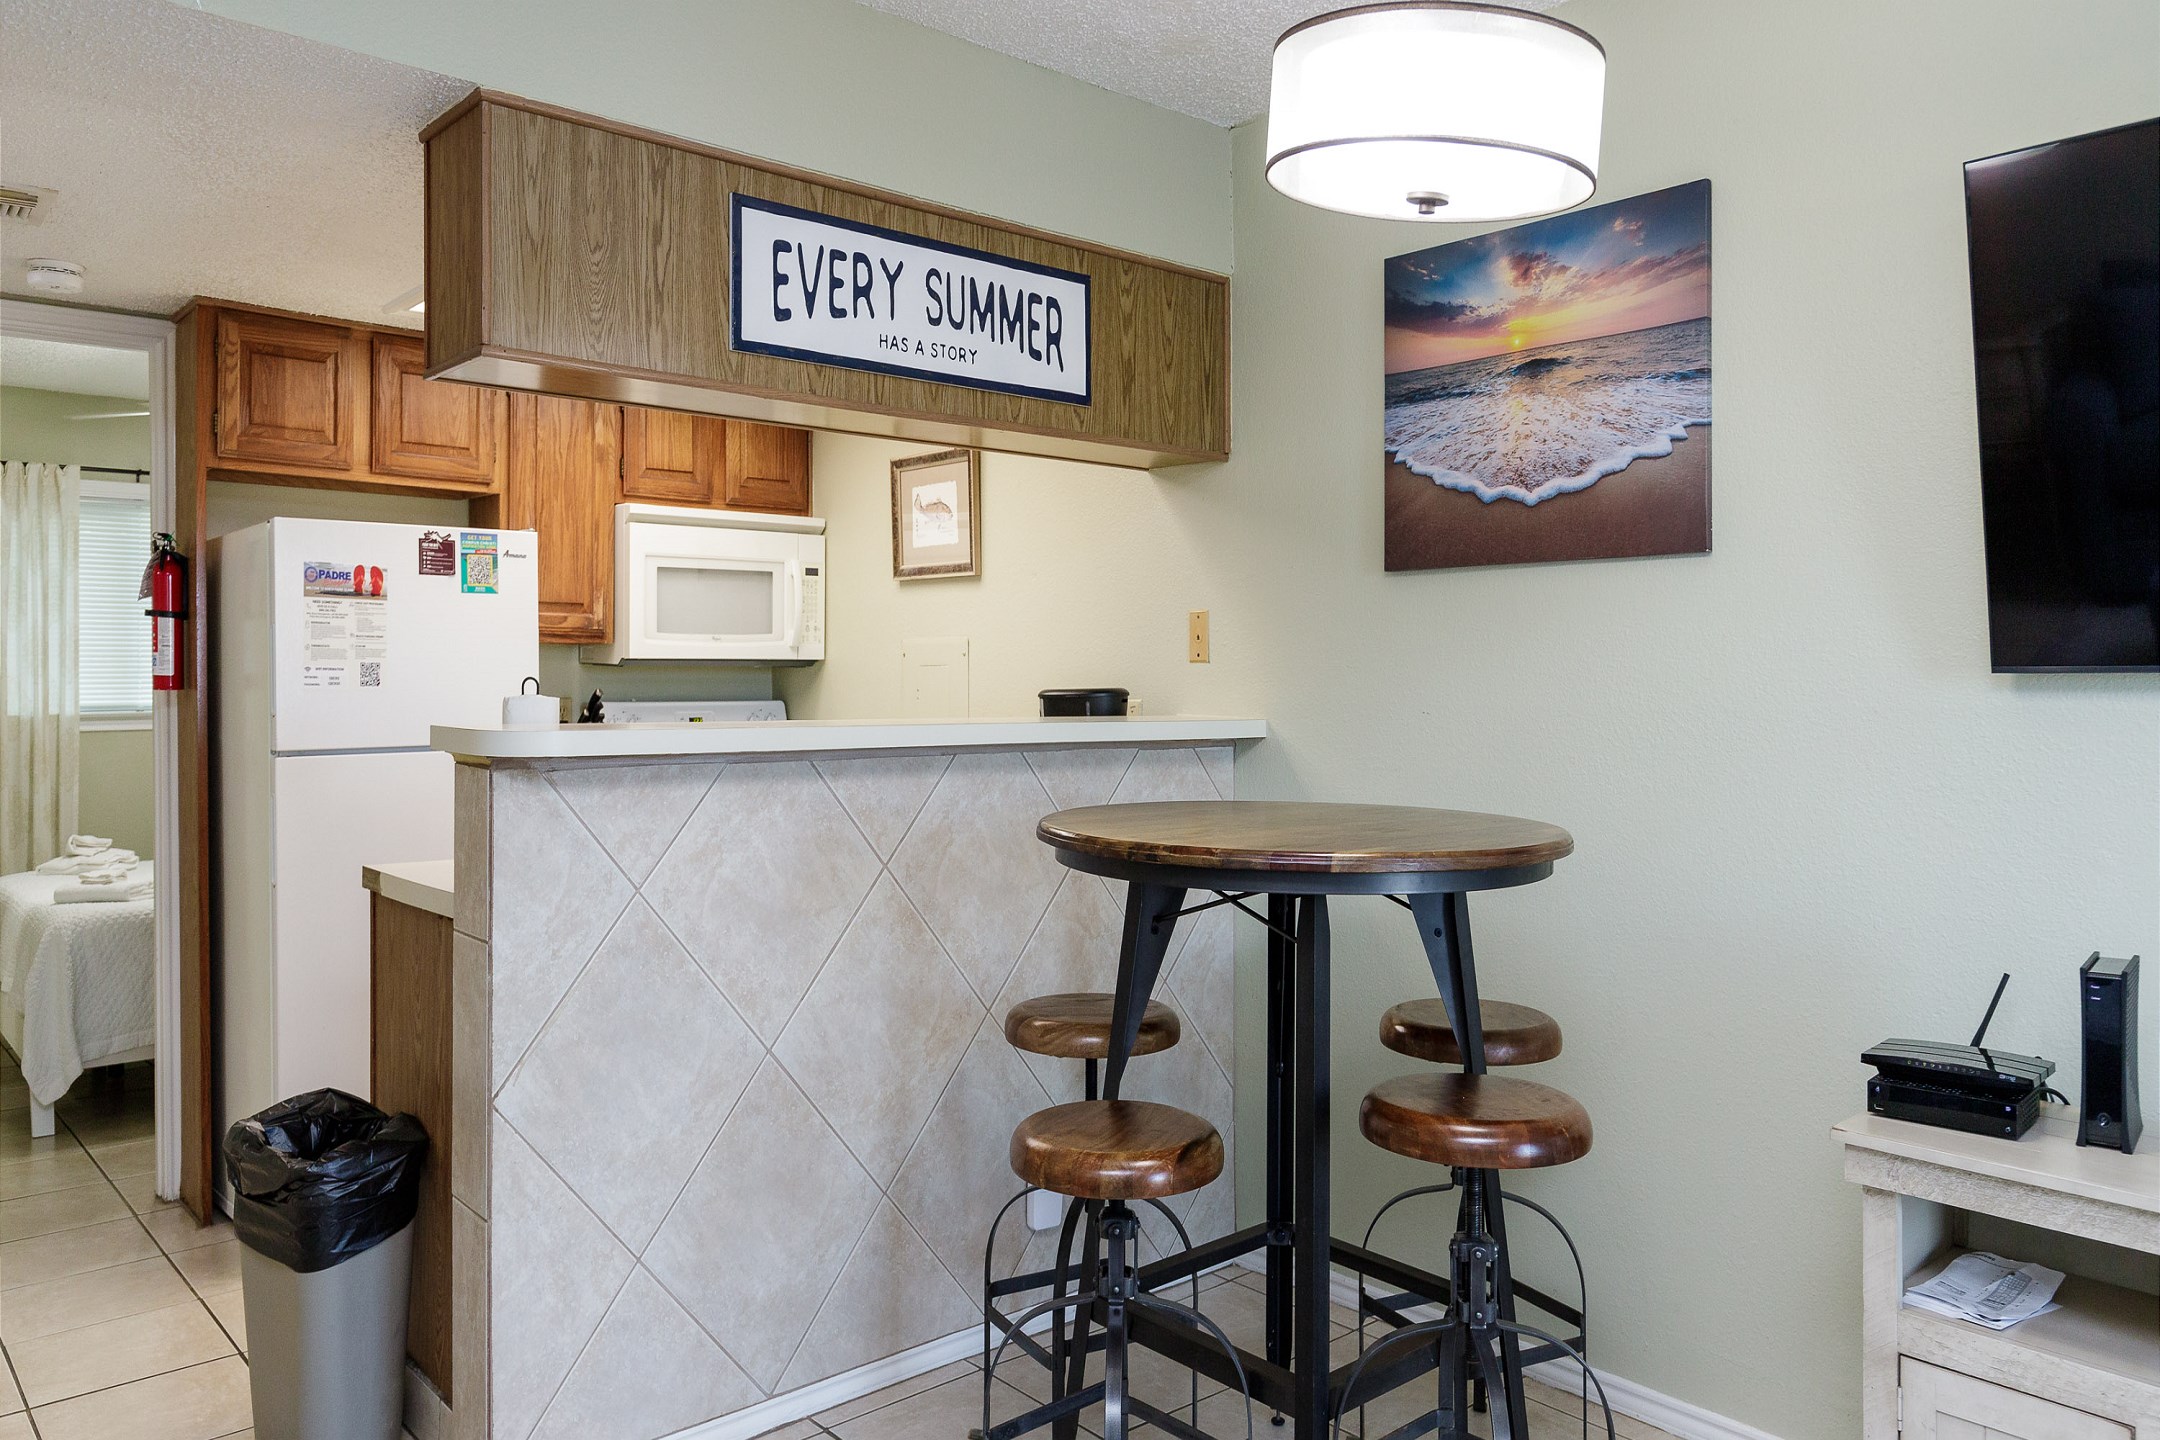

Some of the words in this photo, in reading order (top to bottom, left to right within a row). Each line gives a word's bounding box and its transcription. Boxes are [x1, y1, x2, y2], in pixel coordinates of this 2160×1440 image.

[772, 239, 904, 322] EVERY
[925, 267, 1064, 373] SUMMER
[879, 333, 909, 353] HAS
[914, 340, 925, 356] A
[930, 343, 978, 365] STORY
[318, 569, 352, 581] PADRE
